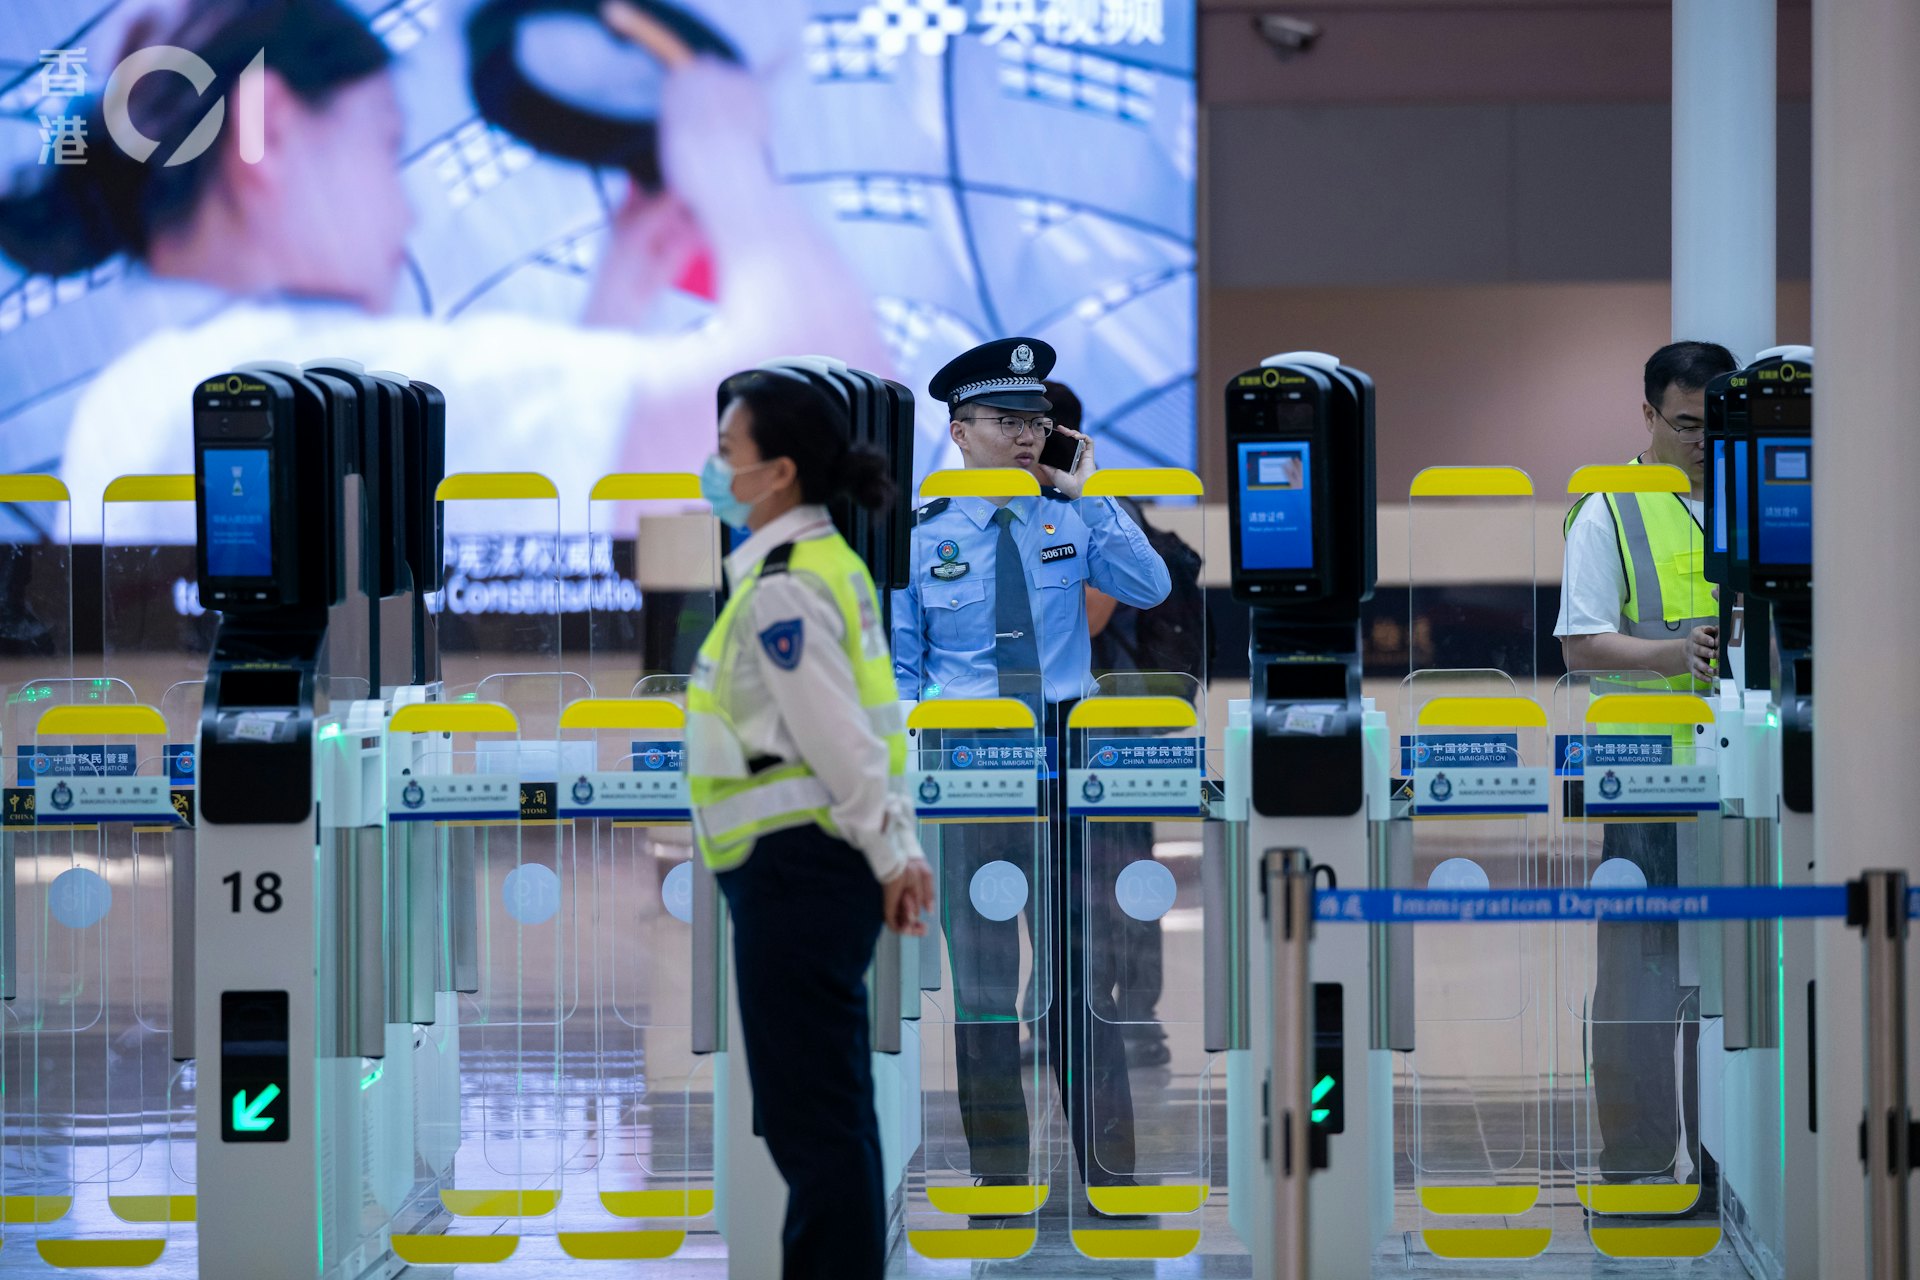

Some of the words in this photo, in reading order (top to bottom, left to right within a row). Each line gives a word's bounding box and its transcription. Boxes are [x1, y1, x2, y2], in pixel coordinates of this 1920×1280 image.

[976, 0, 1165, 45] 央视频
[1280, 376, 1306, 384] Camera
[243, 383, 266, 392] Camera
[1041, 545, 1074, 561] 306770
[976, 746, 1048, 759] 中国移民管理
[1121, 745, 1195, 758] 中国移民管理
[1432, 742, 1508, 754] 中国移民管理
[1594, 743, 1663, 755] 中国移民管理
[53, 753, 129, 765] 中国移民管理
[521, 807, 548, 815] STOMS
[222, 871, 283, 914] 18
[1393, 895, 1552, 920] Immigration
[1558, 893, 1708, 919] Department
